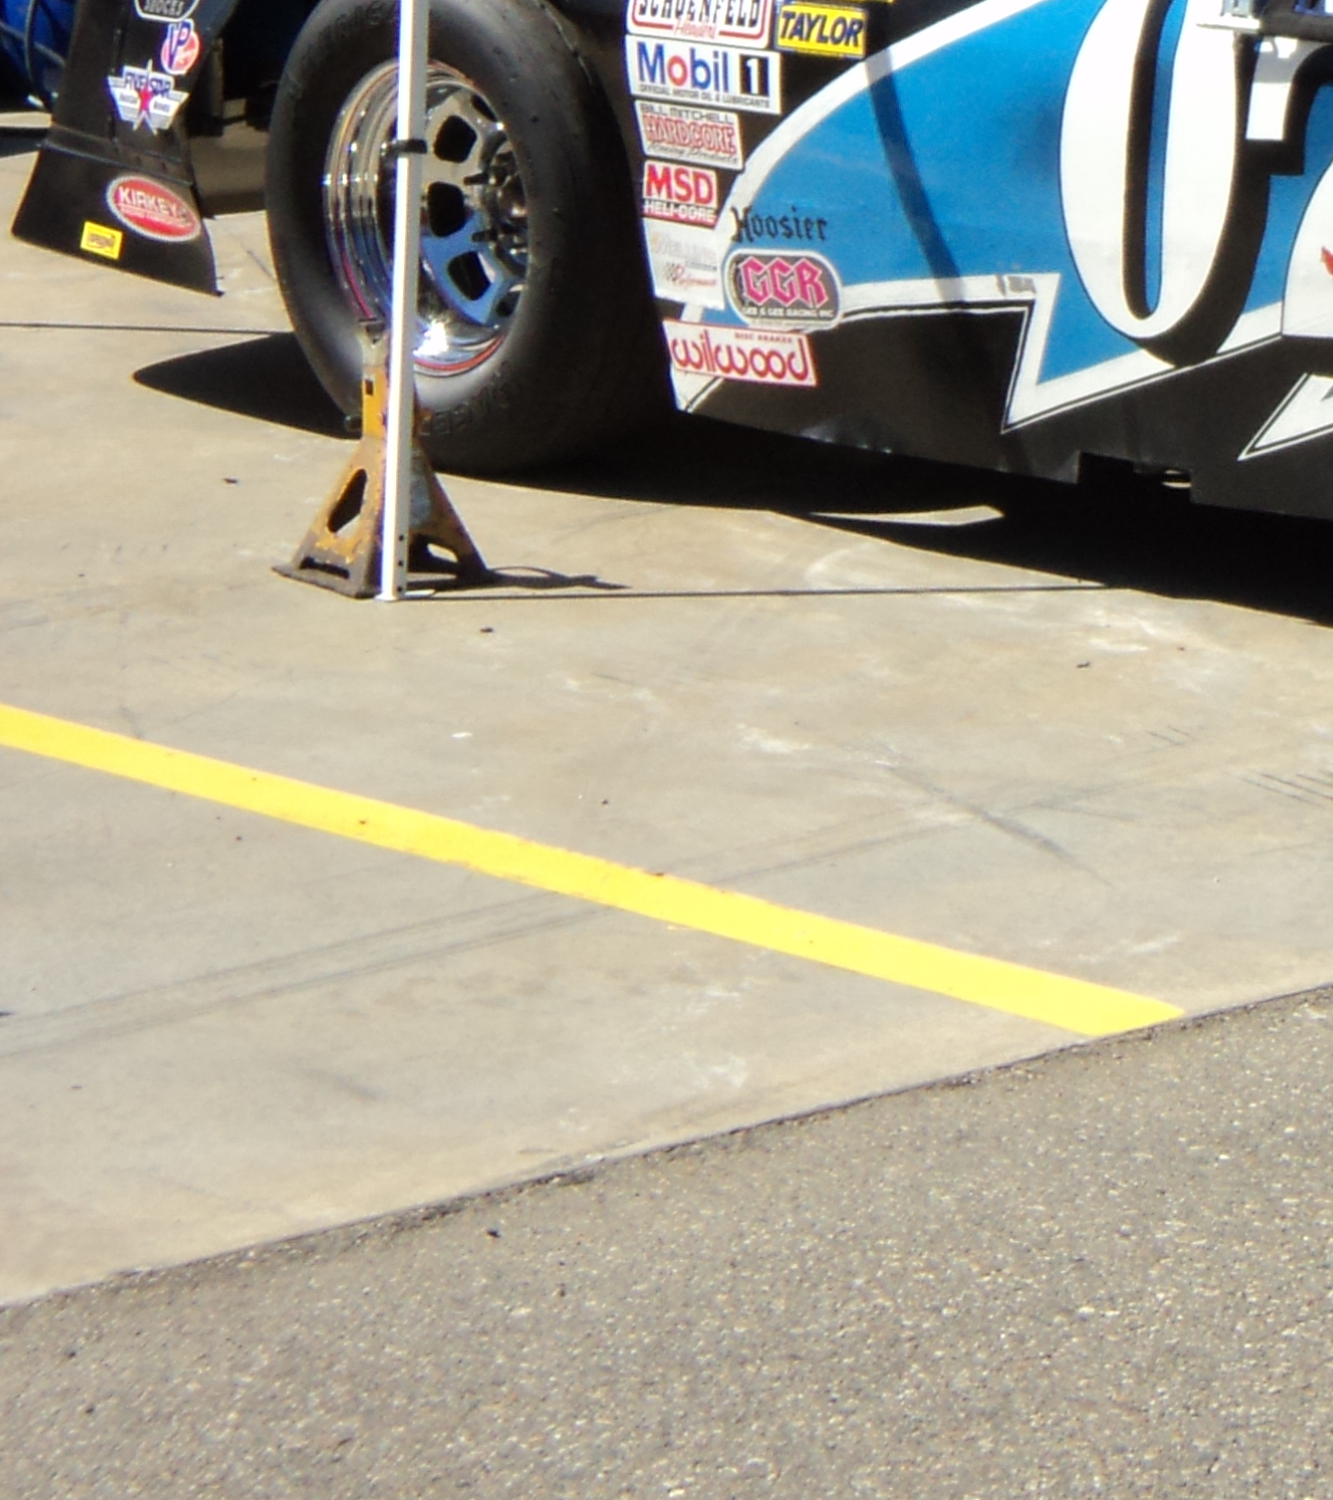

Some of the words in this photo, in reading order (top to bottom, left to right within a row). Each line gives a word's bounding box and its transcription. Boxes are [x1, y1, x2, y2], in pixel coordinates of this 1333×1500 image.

[779, 9, 865, 48] TAYLOR
[636, 41, 730, 94] Mobil
[643, 113, 738, 155] HARDCORE
[119, 185, 178, 218] KIRKEY
[645, 163, 714, 207] MSD
[730, 204, 828, 243] Hoosier
[670, 328, 809, 382] wilwood
